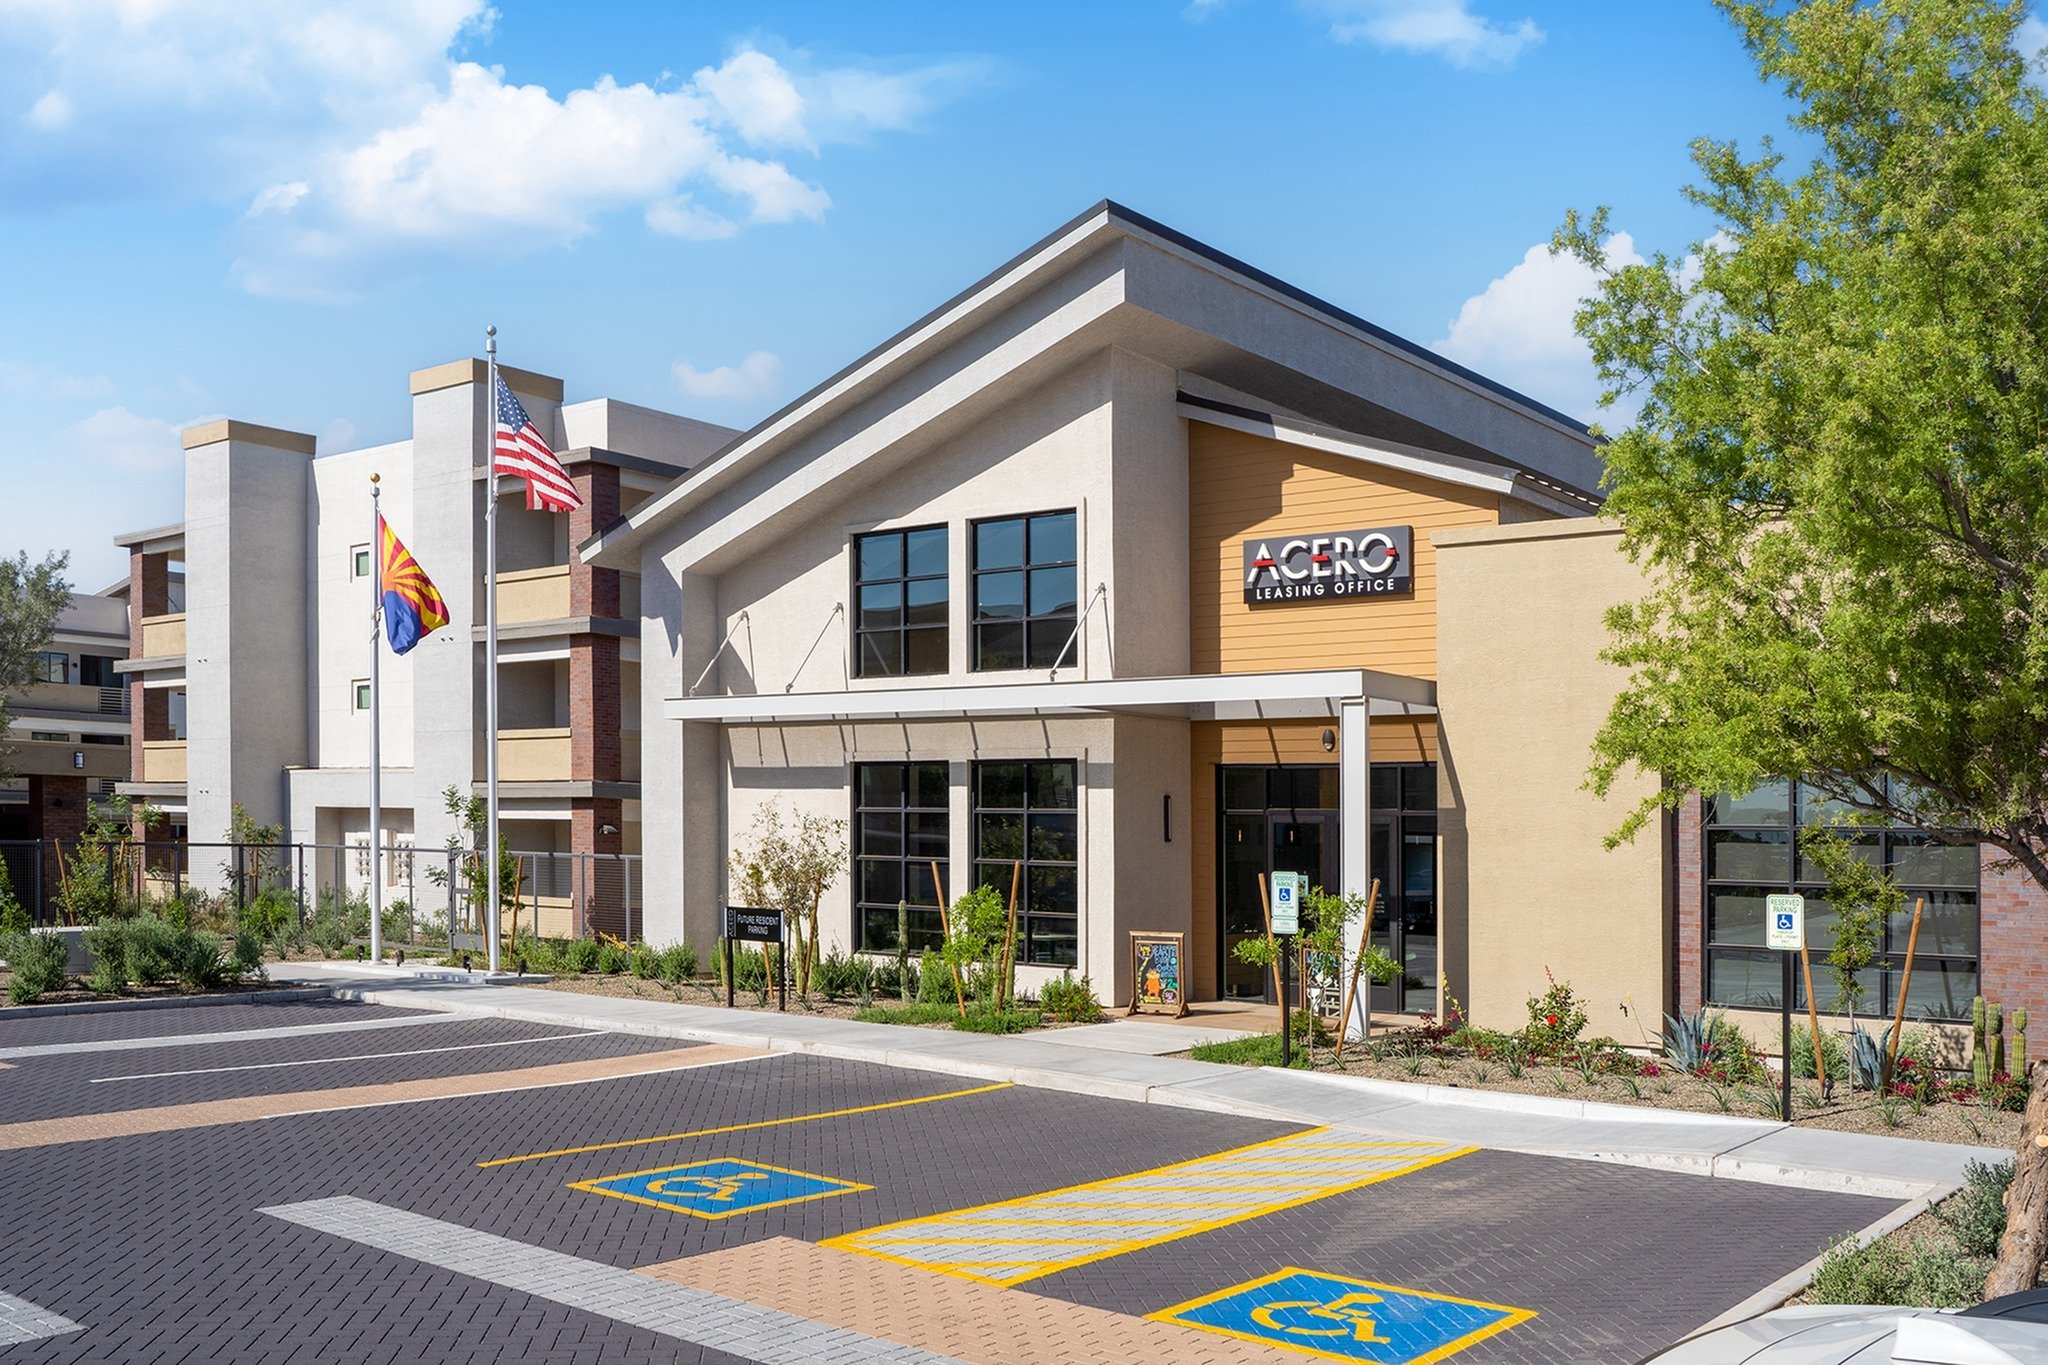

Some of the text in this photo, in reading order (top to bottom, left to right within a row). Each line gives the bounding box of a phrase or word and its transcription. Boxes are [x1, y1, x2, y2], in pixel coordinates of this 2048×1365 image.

[1247, 532, 1397, 582] ACERO
[1256, 578, 1395, 600] LEASING OFFICE
[1771, 898, 1800, 907] RESERVED
[1773, 905, 1797, 913] PARKING
[737, 914, 779, 926] FUTURE RESIDENT
[747, 925, 769, 935] PARKING
